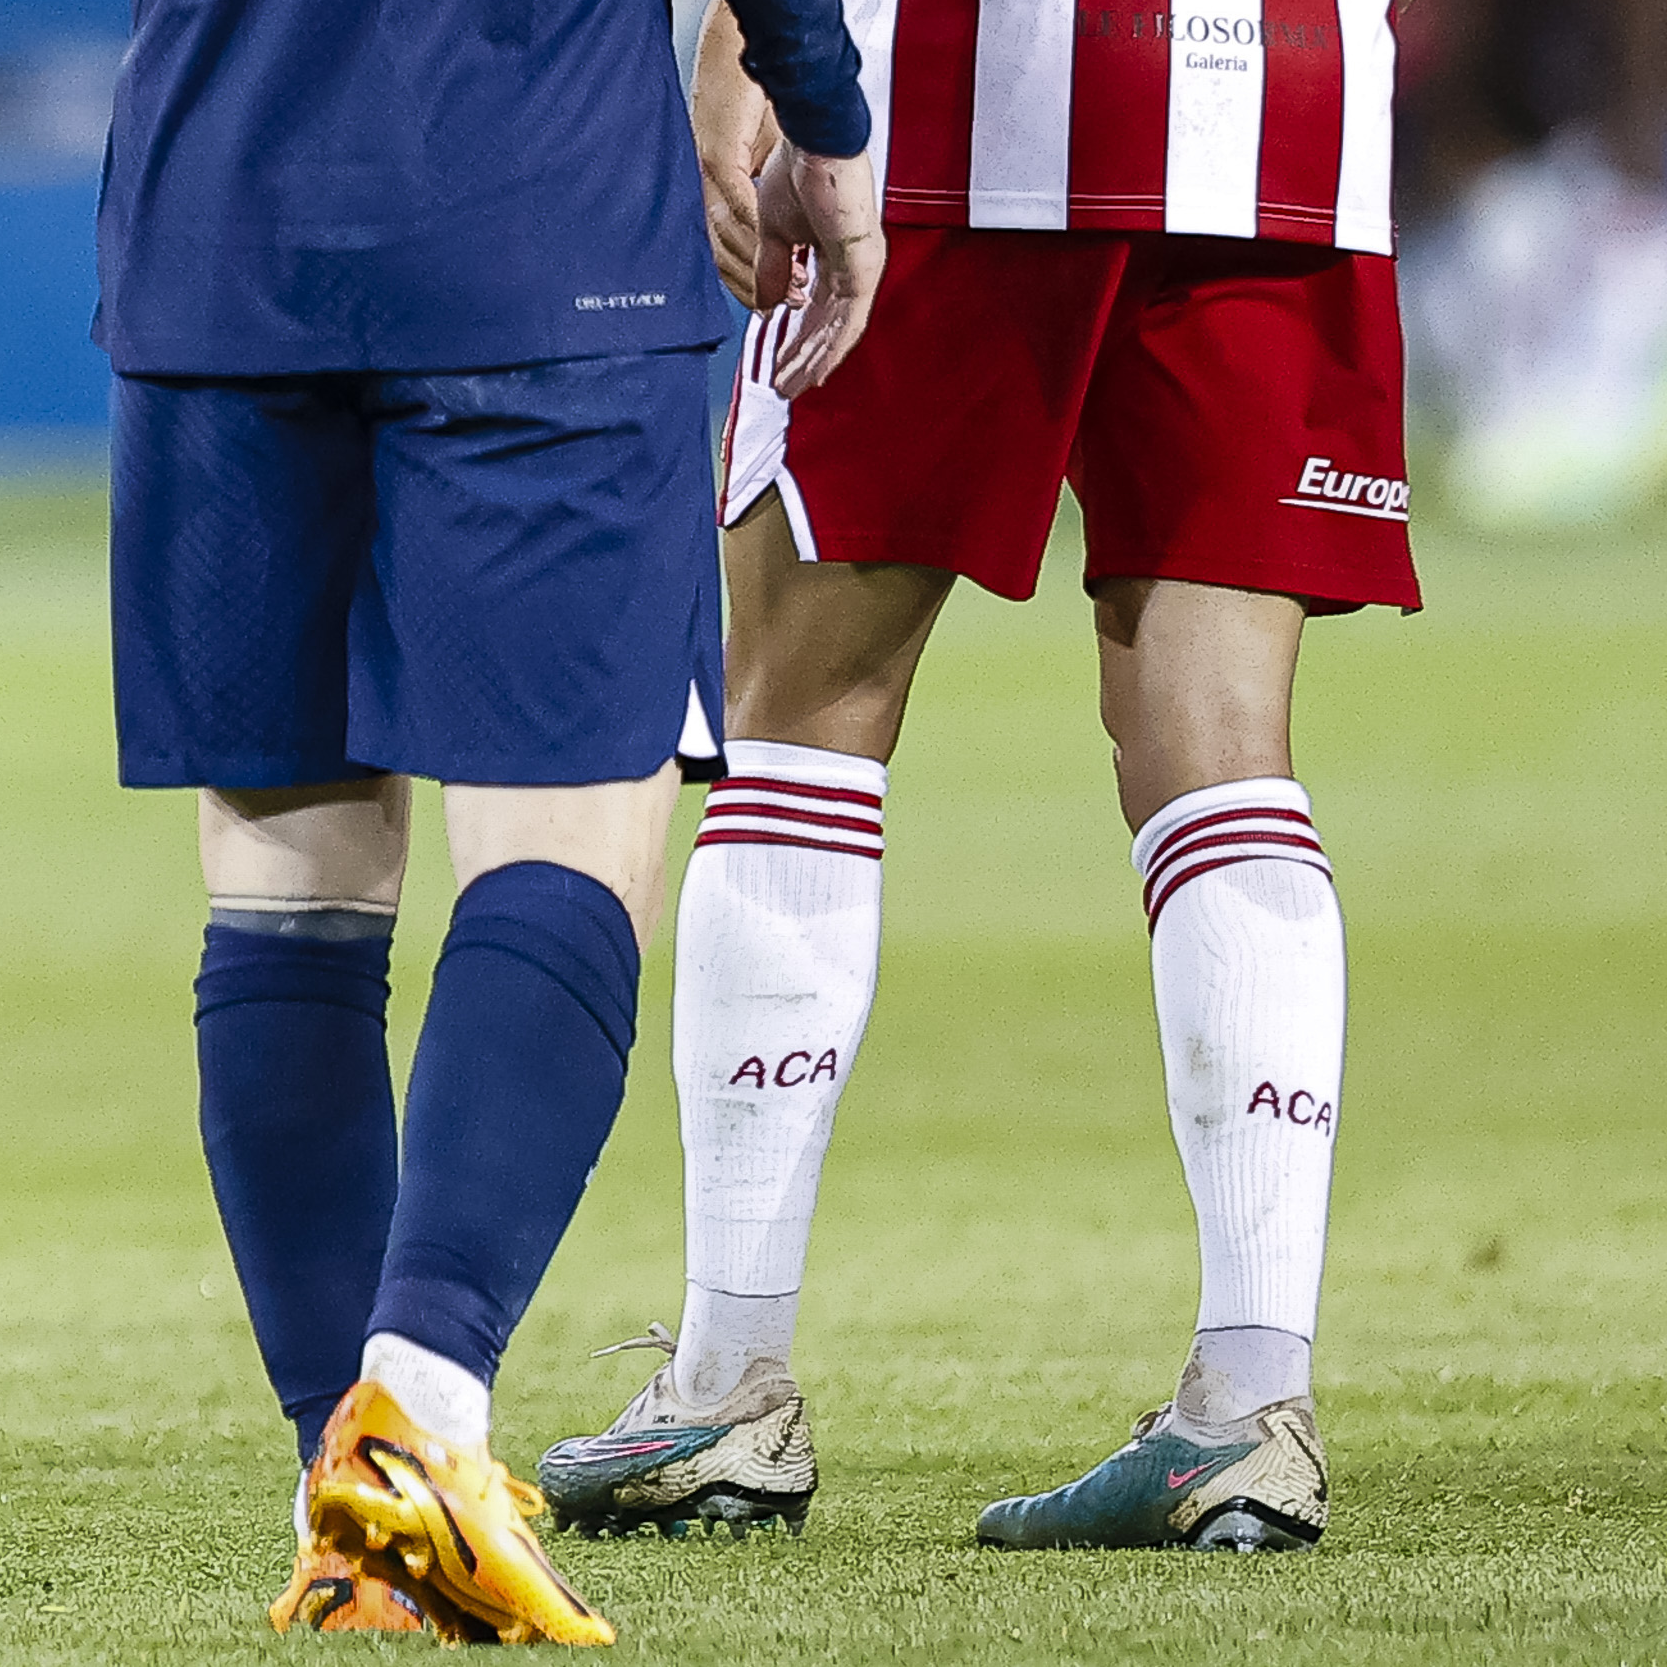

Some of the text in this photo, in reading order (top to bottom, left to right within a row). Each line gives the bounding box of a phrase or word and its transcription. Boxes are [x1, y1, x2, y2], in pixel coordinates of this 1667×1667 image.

[1185, 51, 1249, 73] Galeria
[728, 1048, 838, 1089] ACA
[1247, 1081, 1334, 1137] ACA
